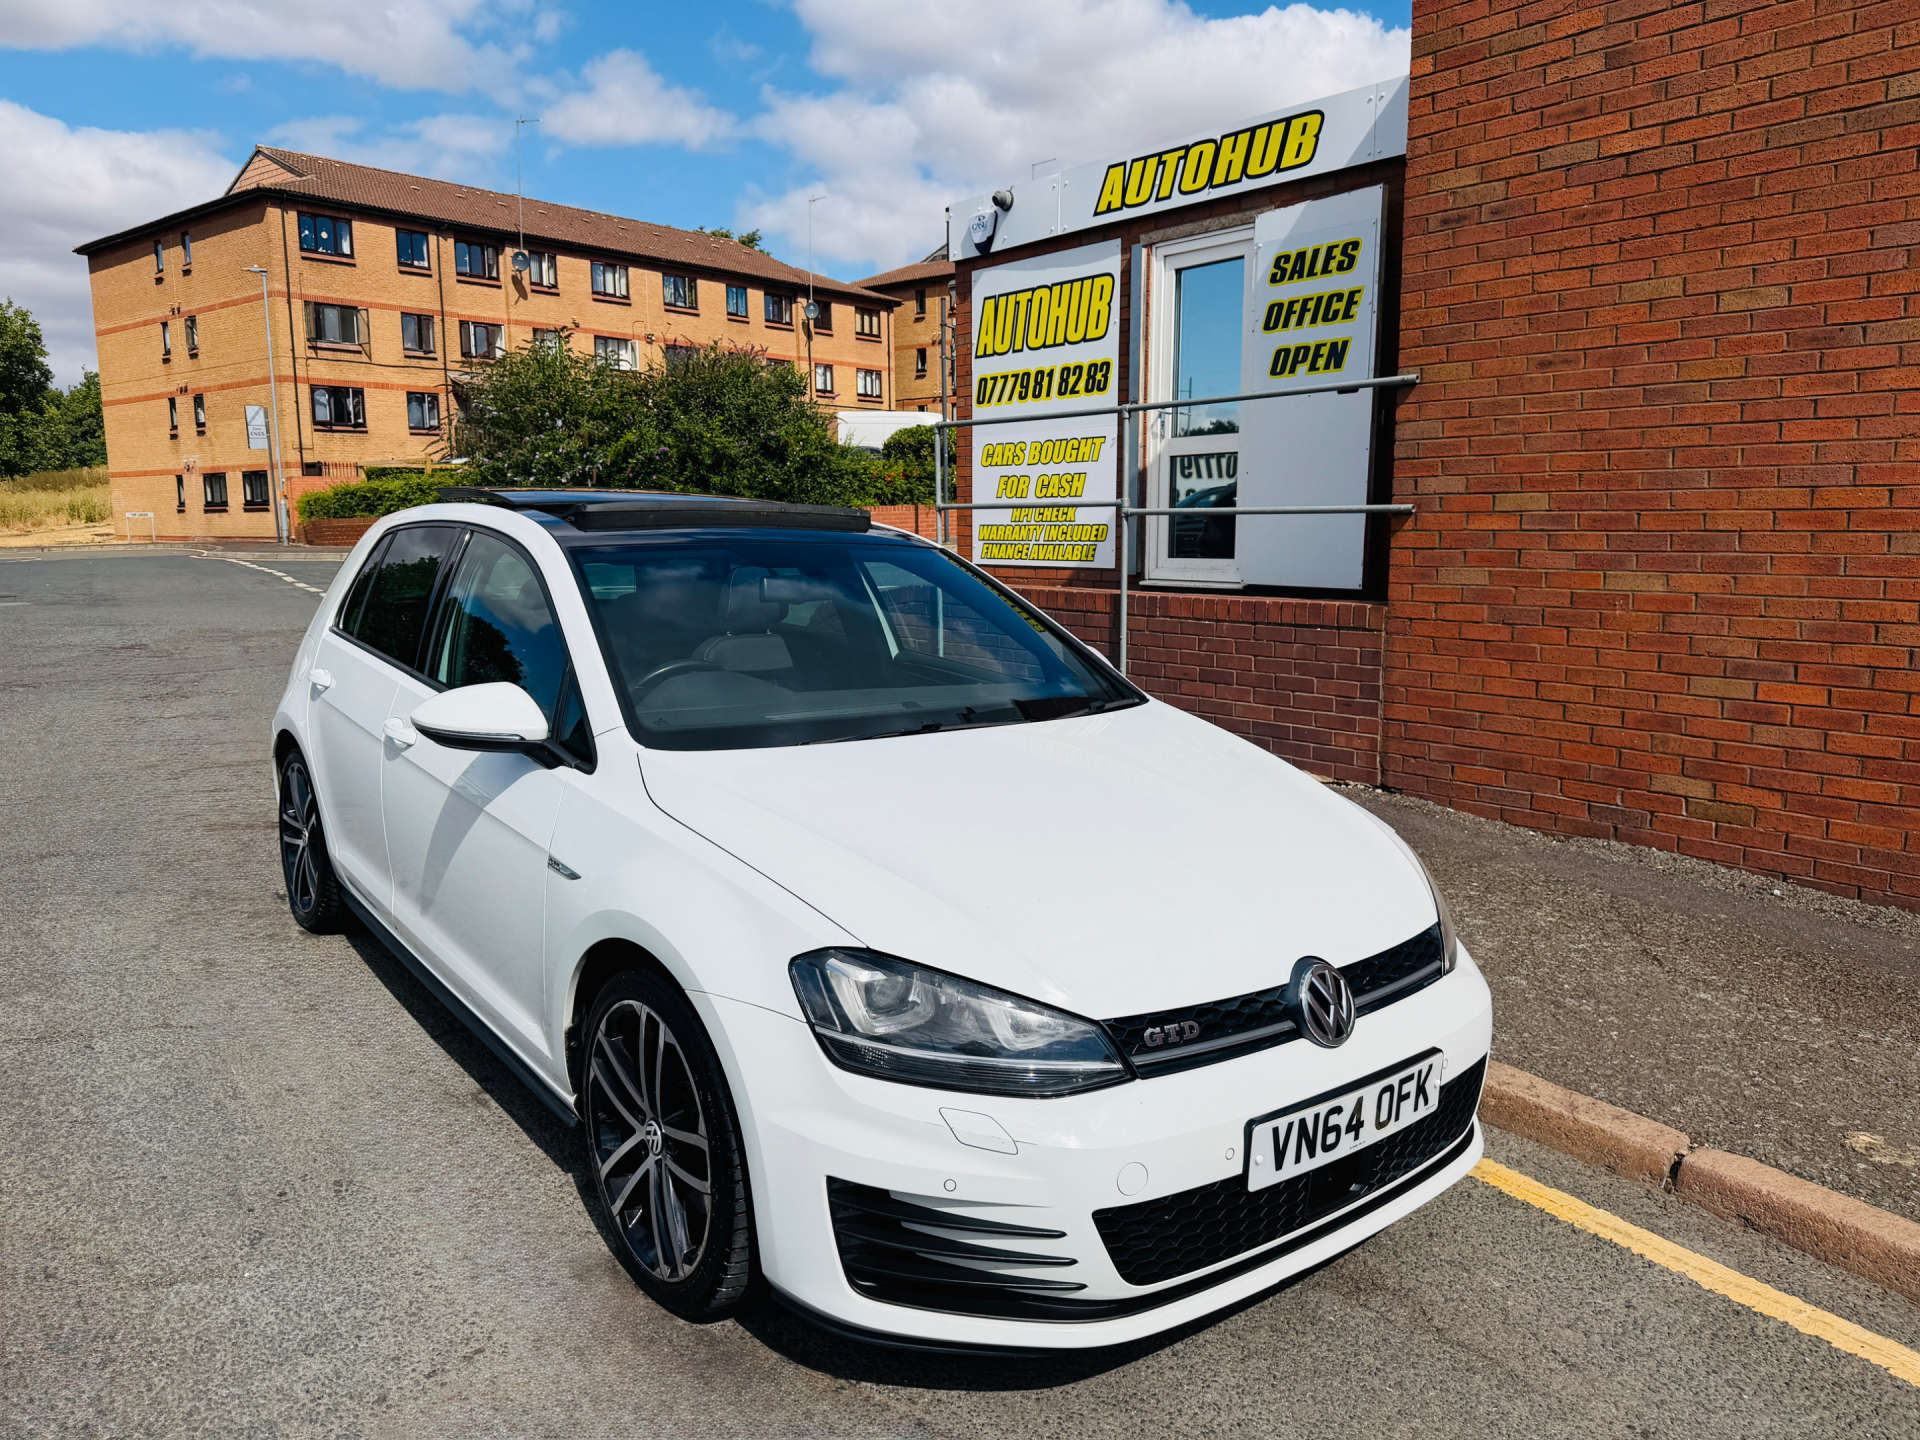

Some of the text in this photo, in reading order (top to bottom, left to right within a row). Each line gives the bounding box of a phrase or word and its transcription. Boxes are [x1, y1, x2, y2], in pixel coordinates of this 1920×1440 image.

[1093, 109, 1325, 217] AUTOHUB
[1268, 237, 1362, 286] SALES
[975, 272, 1115, 359] AUTOHUB
[1262, 286, 1365, 334] OFFICE
[1268, 337, 1352, 379] OPEN
[981, 436, 1106, 467] CARS BOUGHT
[996, 472, 1086, 498] FOR CASH
[1011, 507, 1078, 522] HPI CHECK
[978, 524, 1108, 542] WARRANTY INCLUDED
[981, 543, 1097, 561] FINANCE AVAILABLE
[1143, 1019, 1200, 1047] GTD
[1272, 1063, 1433, 1172] VN64 OFK
